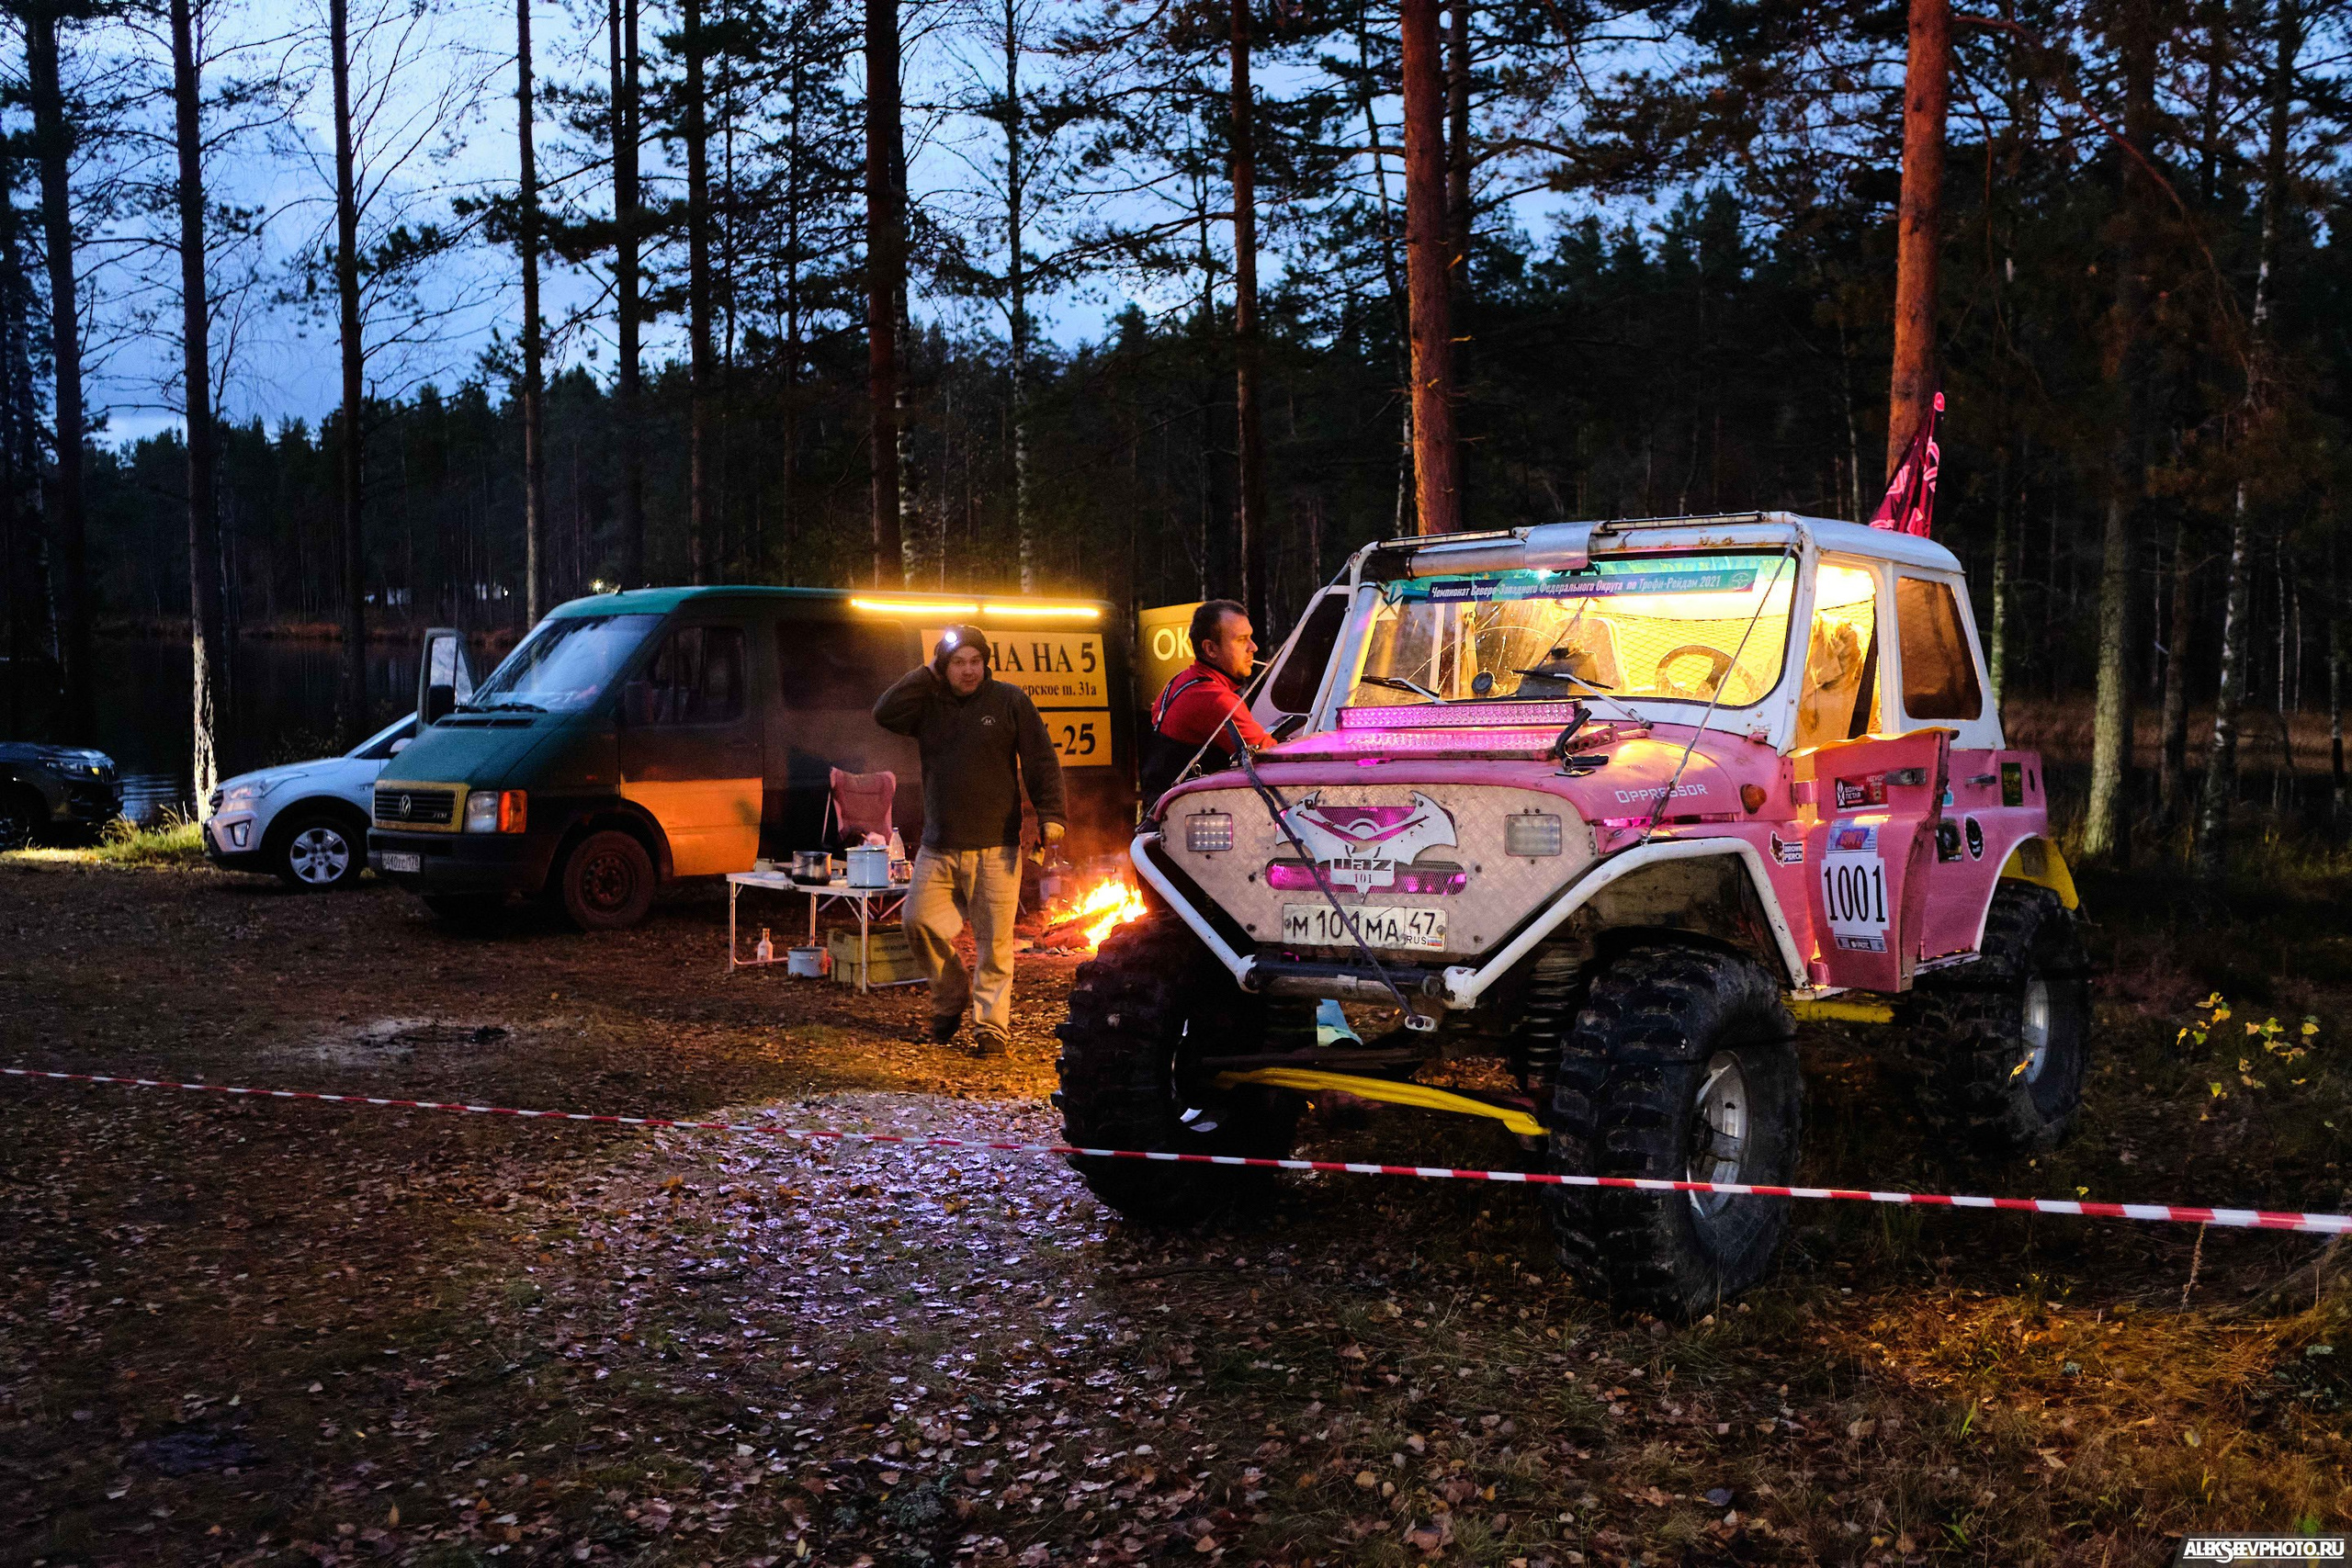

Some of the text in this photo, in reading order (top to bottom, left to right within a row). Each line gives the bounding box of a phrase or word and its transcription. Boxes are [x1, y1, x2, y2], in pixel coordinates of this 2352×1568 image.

[1431, 586, 1470, 598] Чемпионат
[1540, 581, 1594, 595] Федерального
[1596, 580, 1623, 592] Округа
[1626, 582, 1637, 591] по
[1639, 576, 1699, 592] Трофи-Рейдам
[1700, 575, 1721, 588] 2021
[1031, 642, 1073, 672] НА
[1080, 641, 1096, 673] 5
[1023, 681, 1097, 697] ерское ш. 31а
[1053, 722, 1096, 755] -25
[1354, 874, 1372, 884] 101
[1824, 864, 1885, 923] 1001
[1409, 912, 1435, 935] 47
[1406, 936, 1427, 945] RUS
